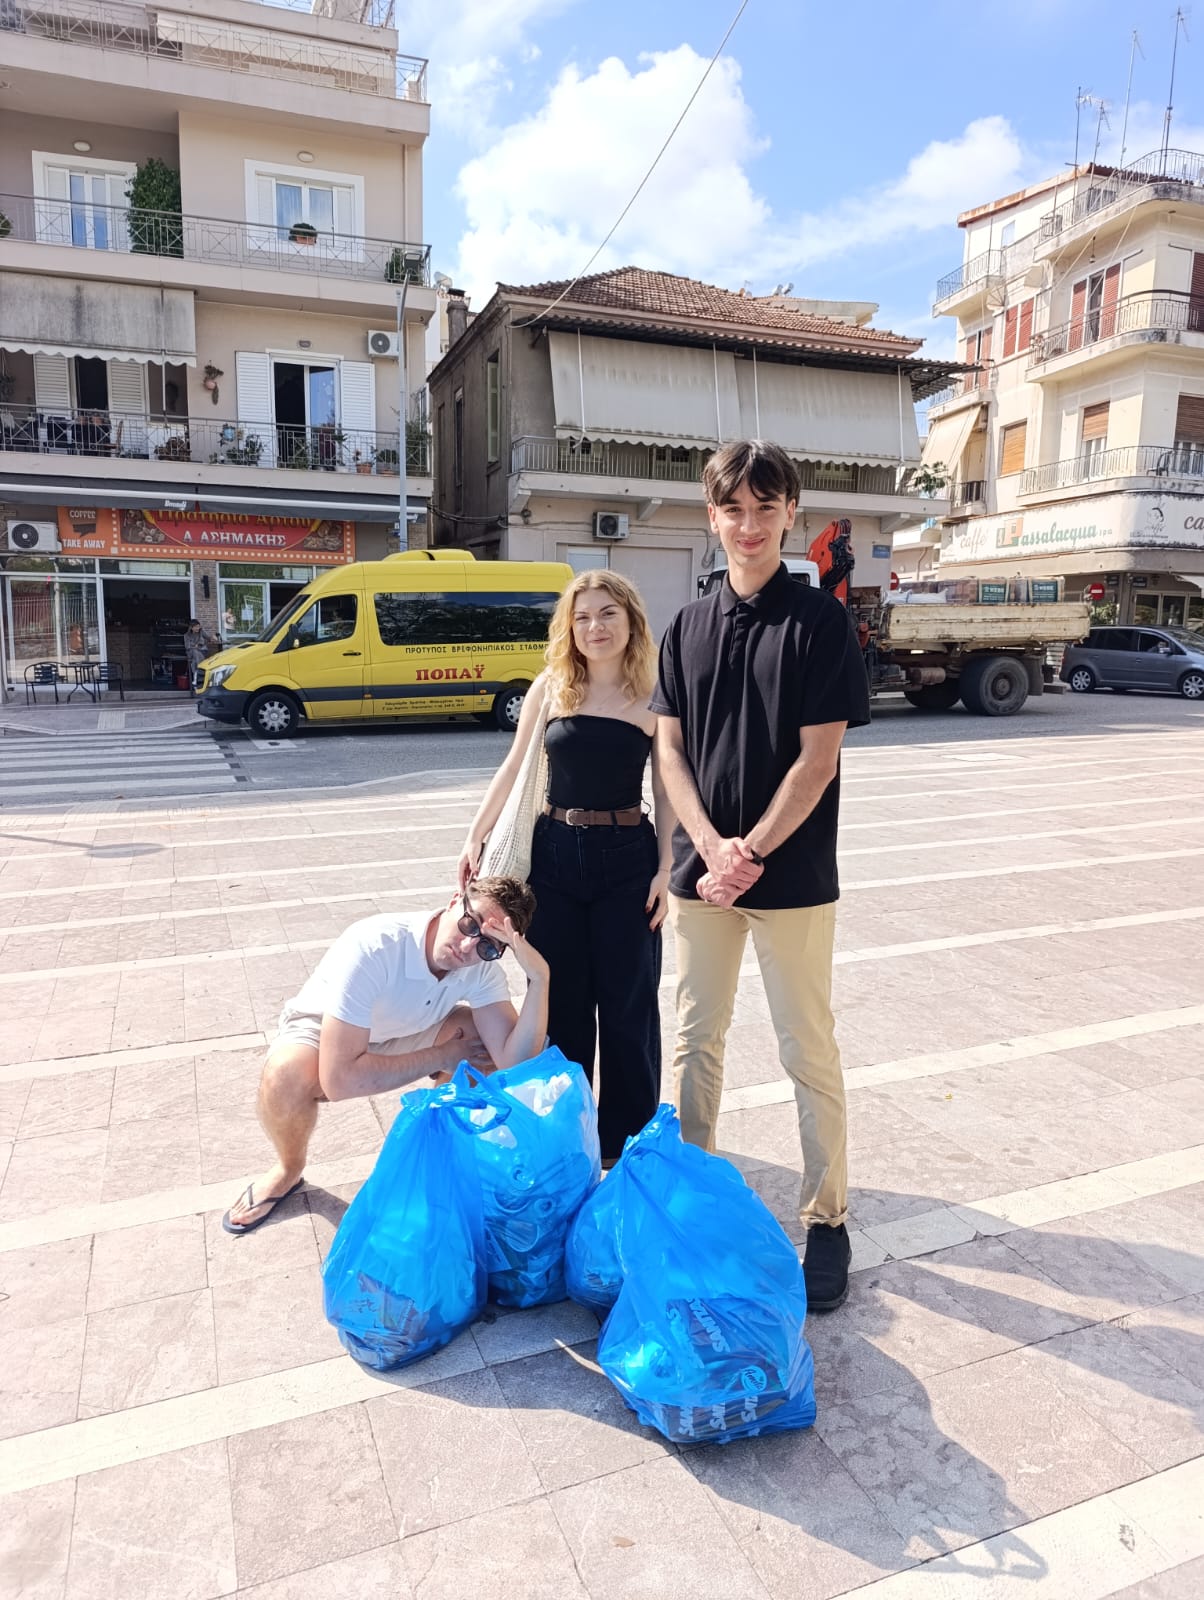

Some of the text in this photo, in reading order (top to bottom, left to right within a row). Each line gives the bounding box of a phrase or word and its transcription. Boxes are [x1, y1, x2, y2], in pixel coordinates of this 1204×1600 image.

[69, 510, 96, 519] COFFEE
[200, 530, 287, 546] ΑΣΗΜΑΚΗΣ
[62, 539, 105, 549] TAKE AWAY
[405, 645, 447, 654] ΠΡΟΤΥΠΟΣ
[451, 643, 515, 653] ΒΡΕΦΟΝΗΠΙΑΚΟΣ
[415, 664, 486, 681] ΠΟΠΑΫ
